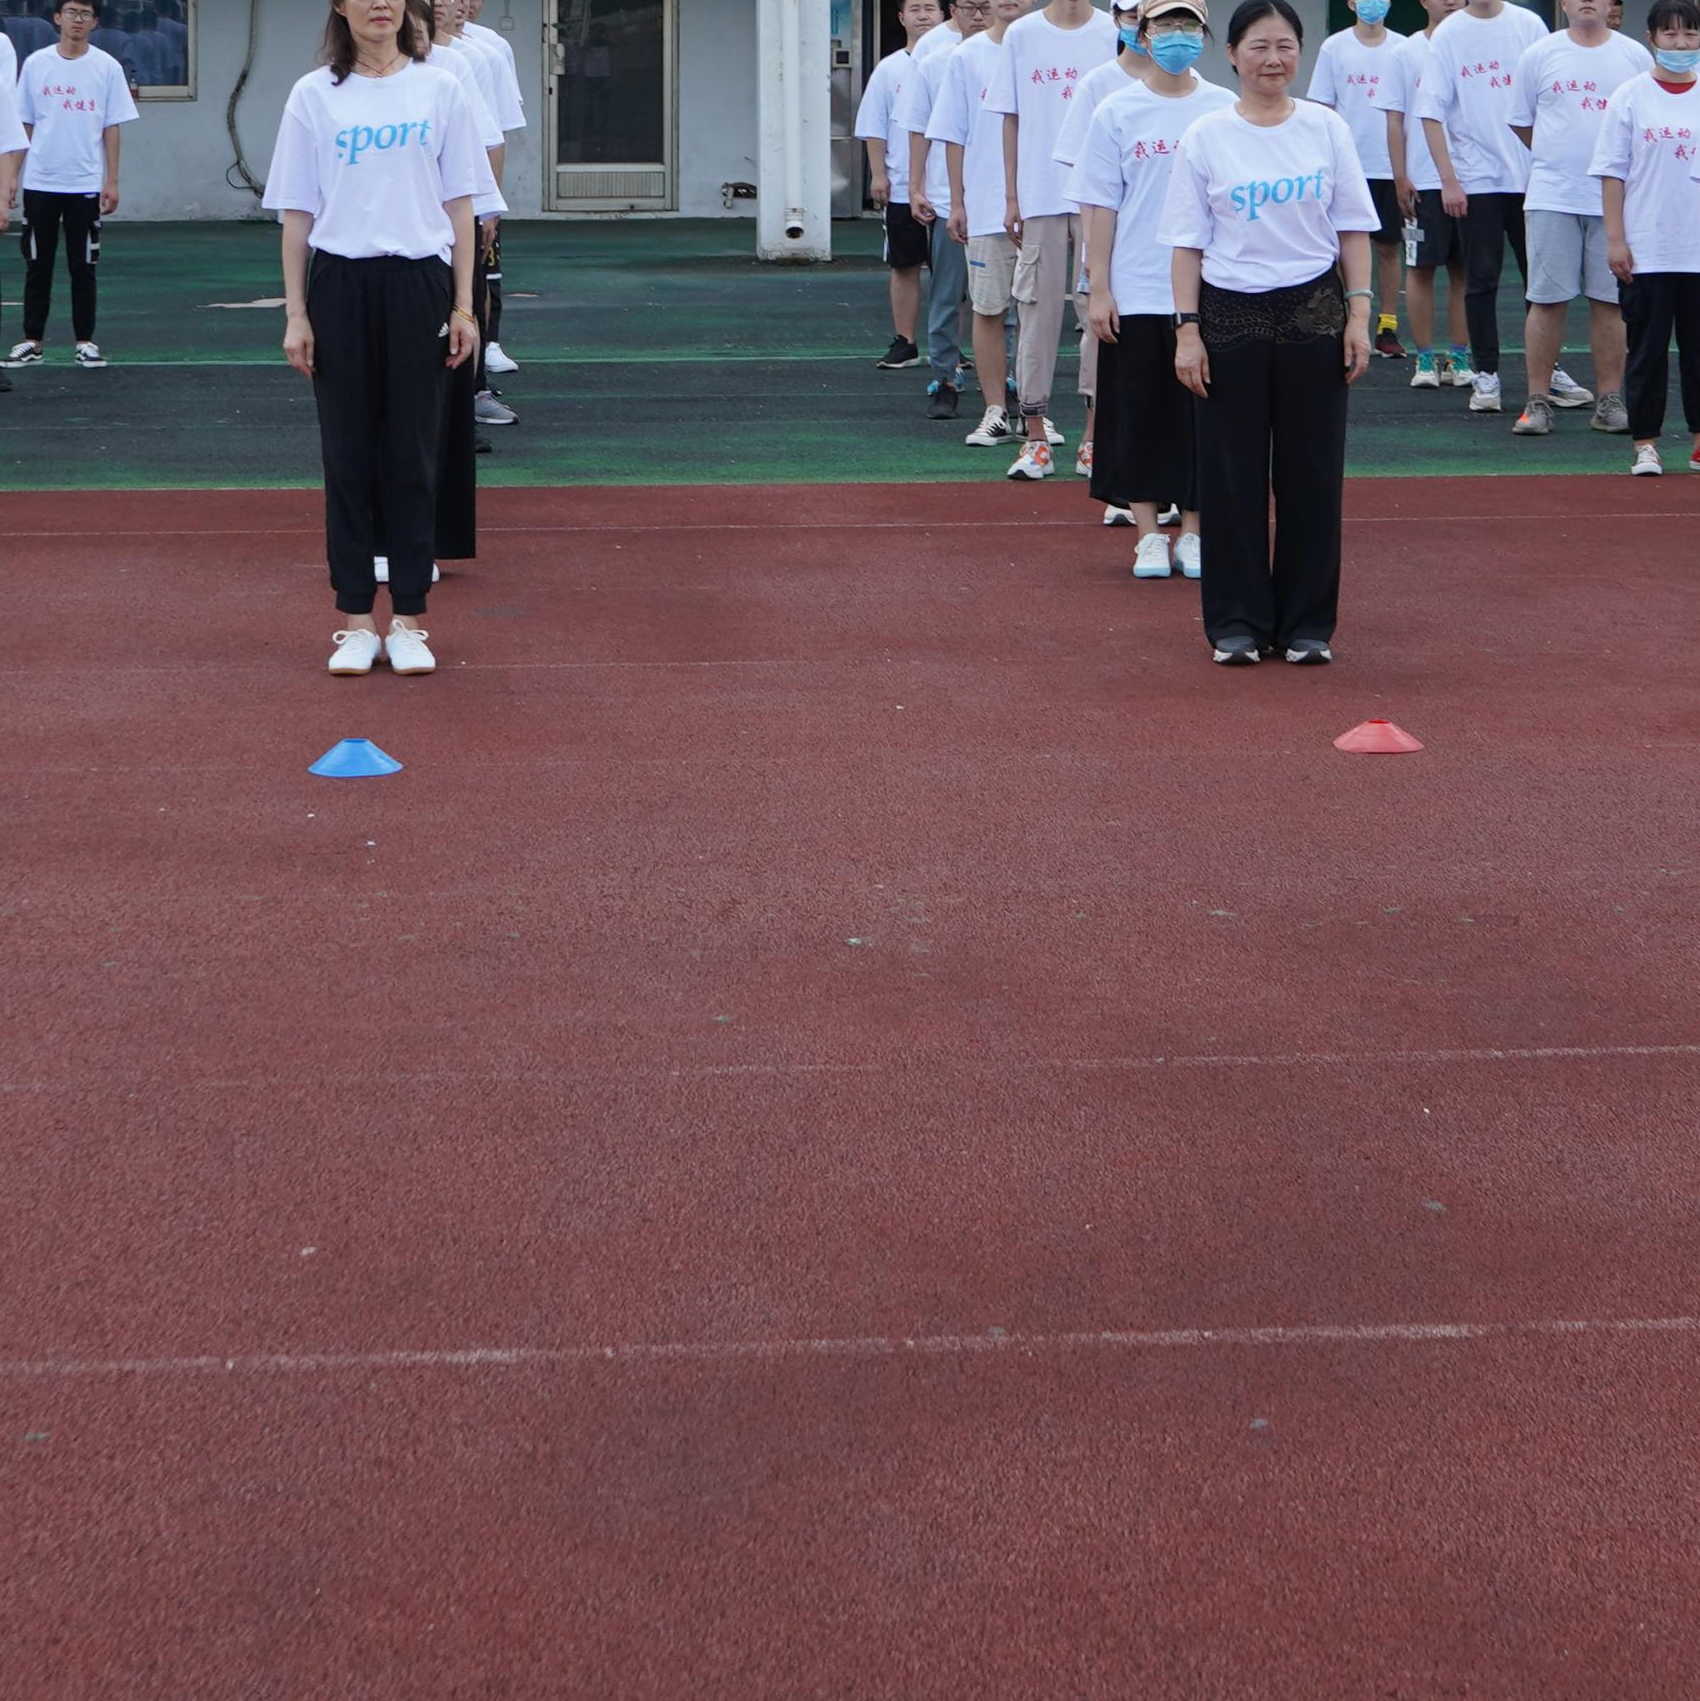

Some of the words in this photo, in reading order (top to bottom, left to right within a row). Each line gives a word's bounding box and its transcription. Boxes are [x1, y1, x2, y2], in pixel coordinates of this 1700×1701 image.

[1030, 67, 1080, 85] 我运动
[1552, 79, 1596, 93] 我运动
[335, 119, 432, 166] sport
[1643, 126, 1693, 142] 我运动
[1133, 139, 1180, 160] 我运
[1230, 168, 1325, 222] sport
